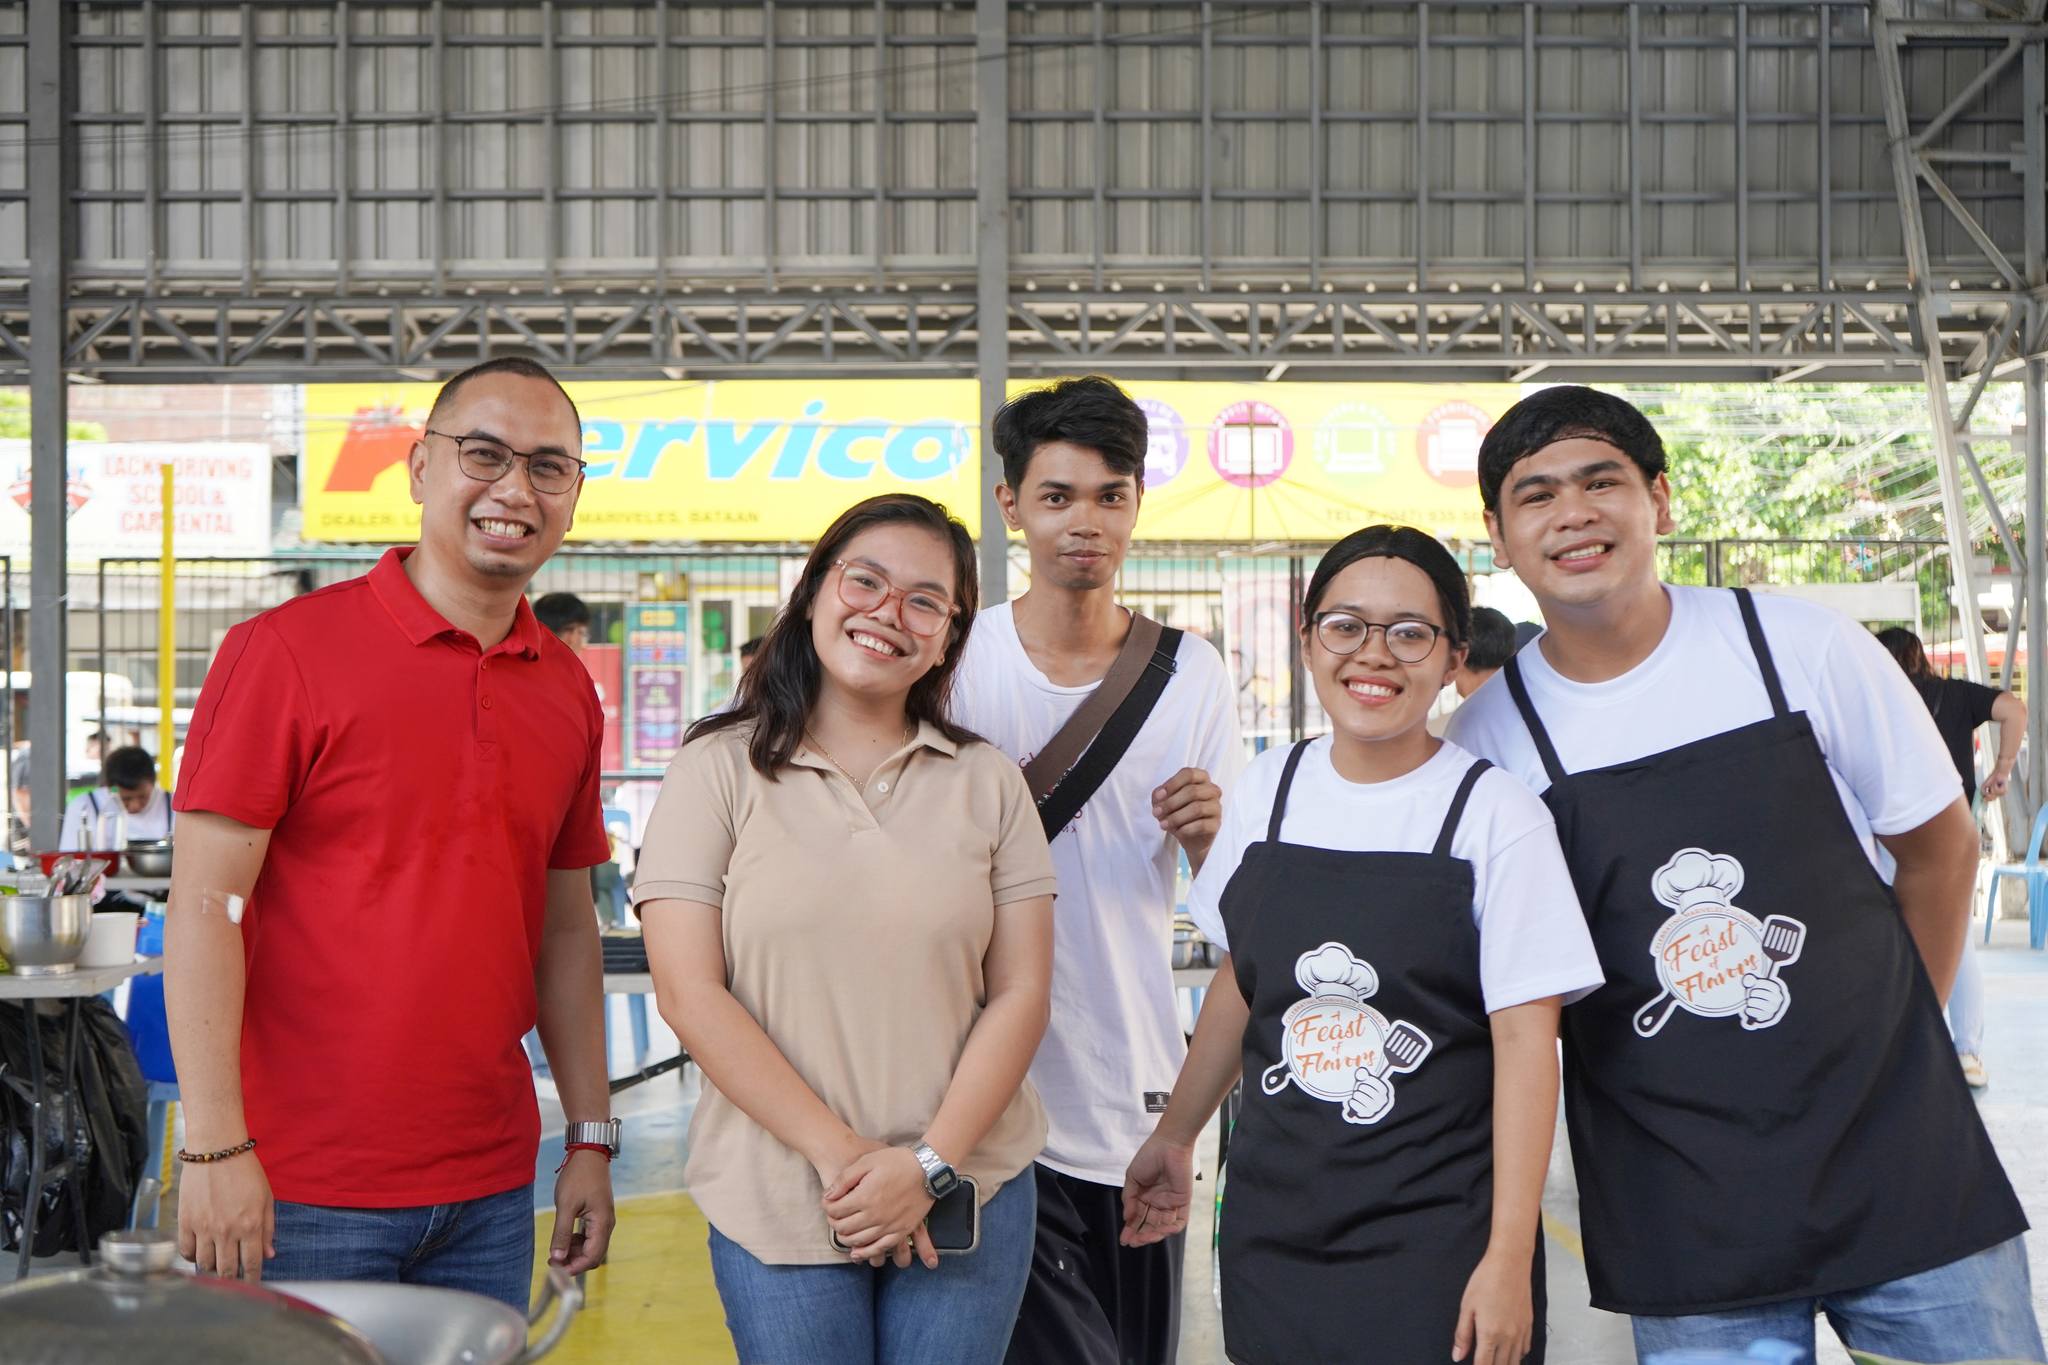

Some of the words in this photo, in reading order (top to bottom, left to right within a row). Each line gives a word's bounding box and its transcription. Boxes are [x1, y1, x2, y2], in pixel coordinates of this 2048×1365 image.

[580, 400, 970, 480] ervico
[172, 456, 254, 480] DRIVING
[129, 483, 207, 505] SCOOL
[170, 510, 234, 534] ENTAL
[1663, 920, 1740, 972] Feast
[1675, 952, 1758, 1003] Flavors
[1292, 1013, 1368, 1047] Feast
[1295, 1050, 1377, 1079] Flavors
